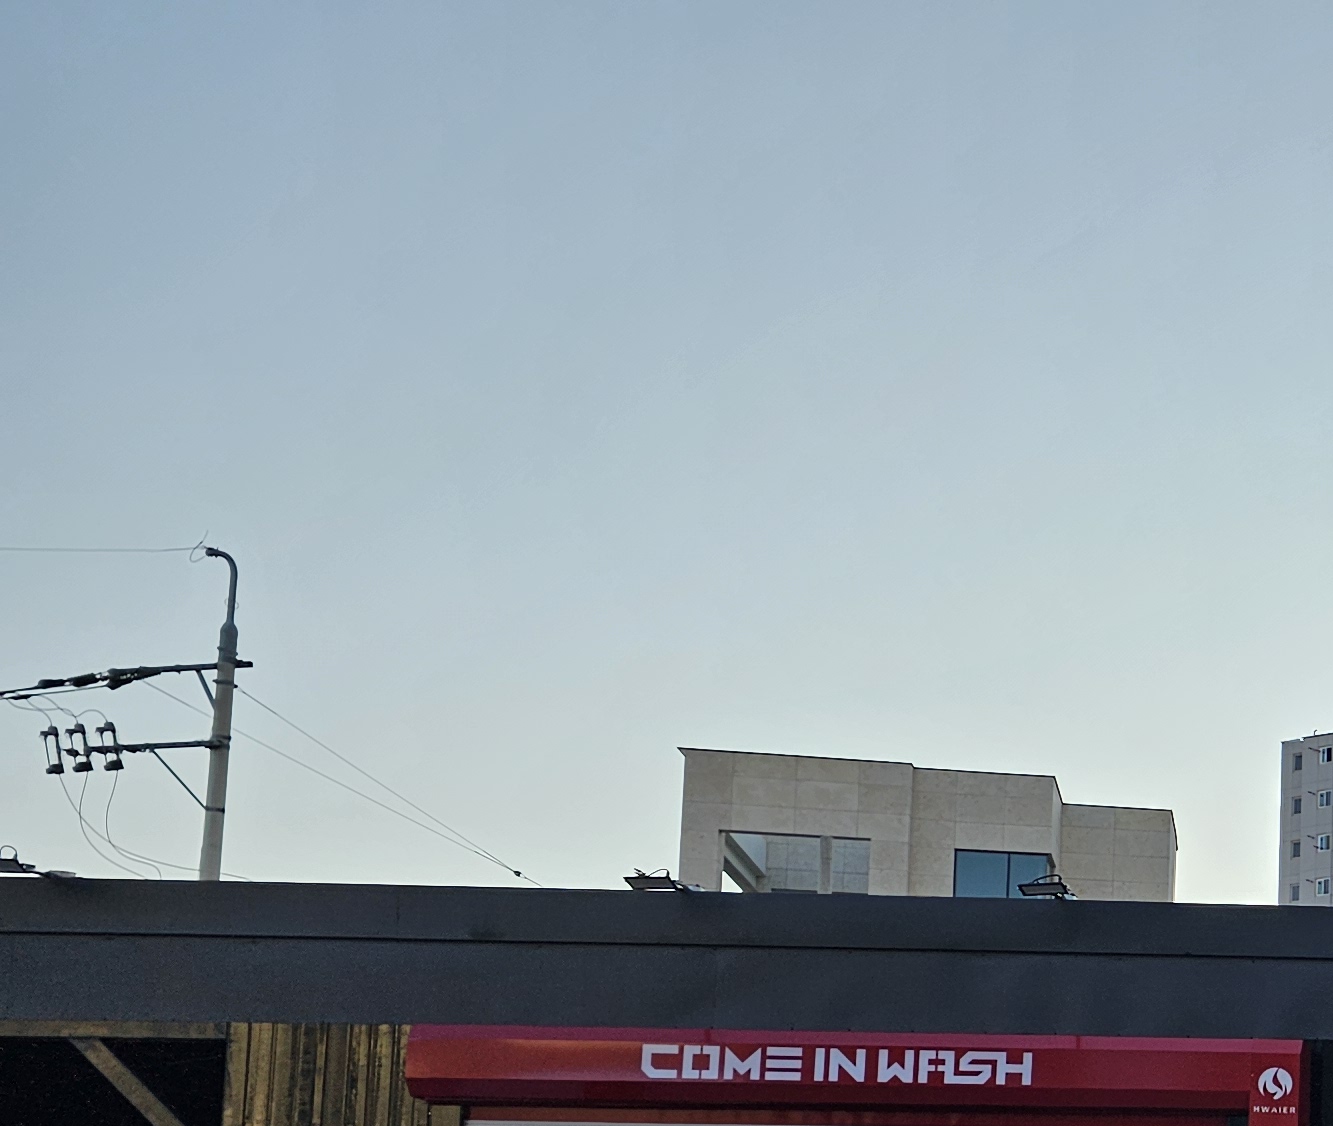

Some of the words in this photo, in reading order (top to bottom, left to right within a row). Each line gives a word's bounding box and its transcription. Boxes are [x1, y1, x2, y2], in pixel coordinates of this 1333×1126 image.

[640, 1043, 803, 1082] COME
[812, 1047, 867, 1084] IN
[876, 1049, 1033, 1086] WASH
[1253, 1105, 1296, 1114] HWAIER
